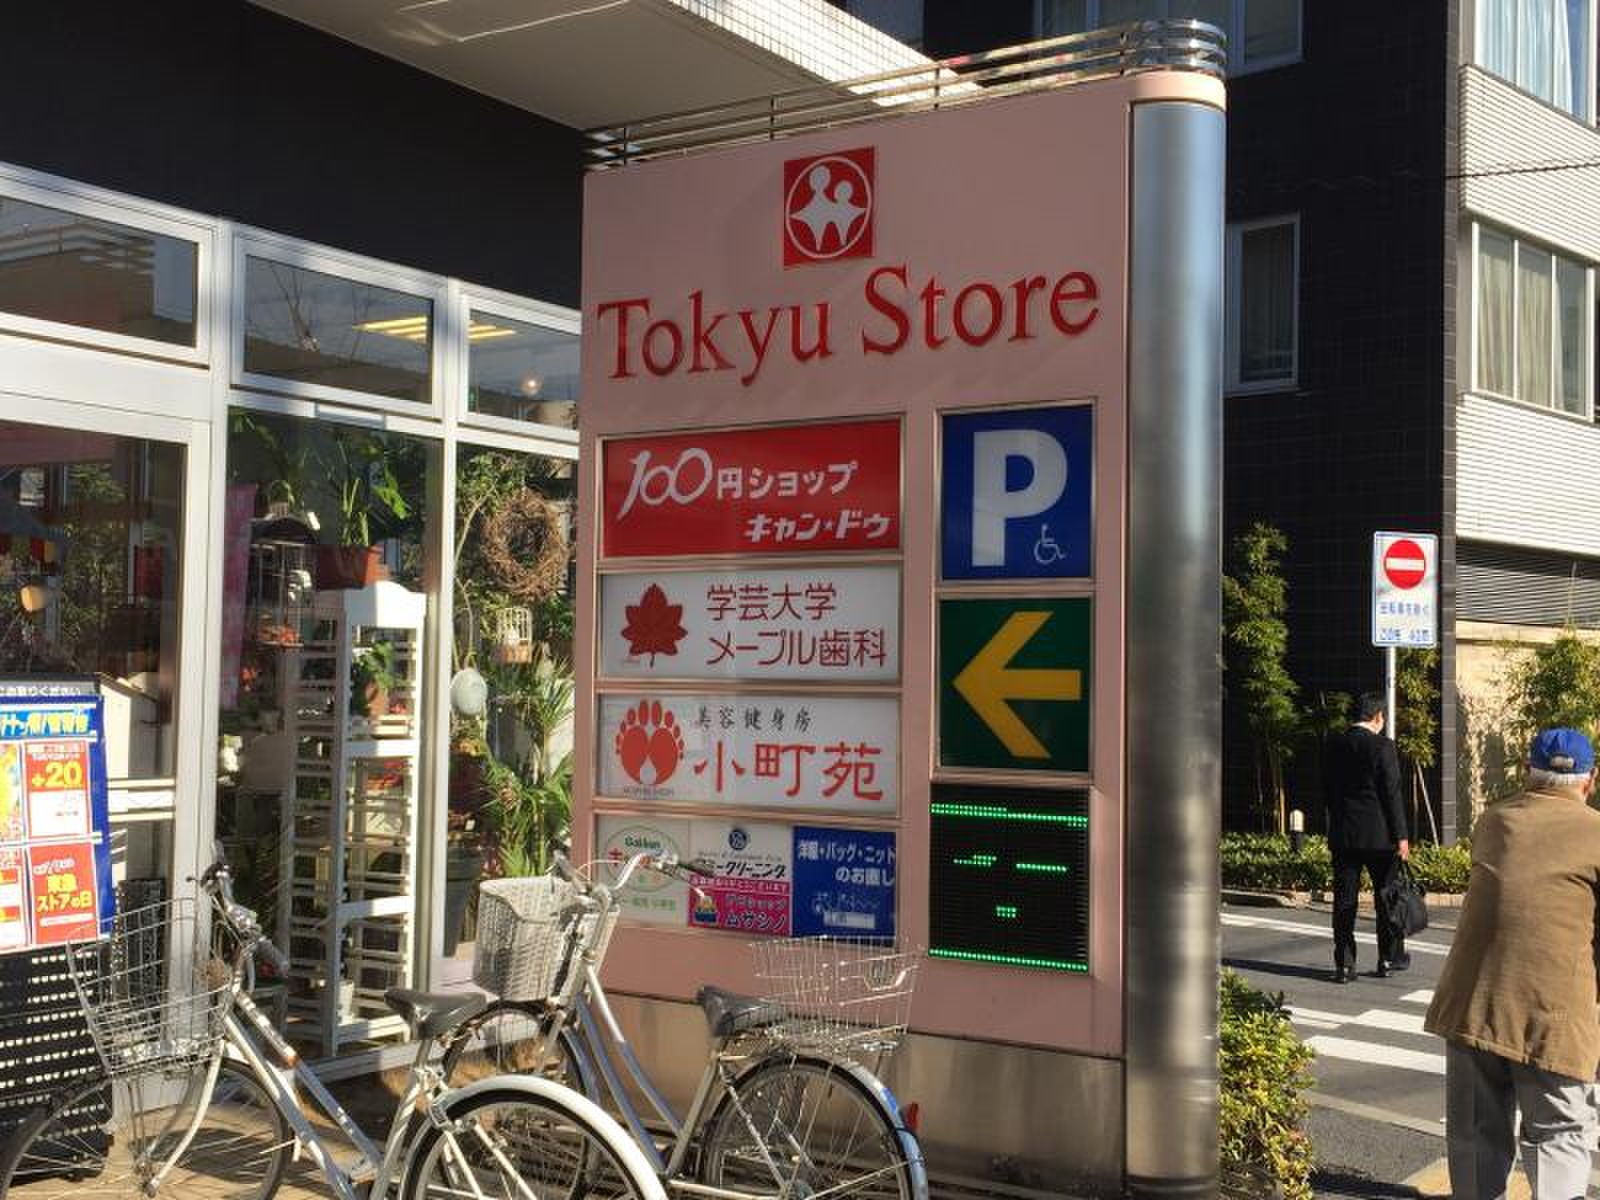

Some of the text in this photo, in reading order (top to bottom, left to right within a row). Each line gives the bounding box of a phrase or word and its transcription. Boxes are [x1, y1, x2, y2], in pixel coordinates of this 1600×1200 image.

[598, 262, 1101, 388] Tokyu Store
[616, 446, 859, 521] 100円ショップ
[971, 428, 1069, 568] P
[706, 582, 838, 622] 学芸大学
[706, 628, 887, 668] メープル歯科
[693, 740, 884, 801] 小町苑
[36, 890, 94, 914] ストアの日
